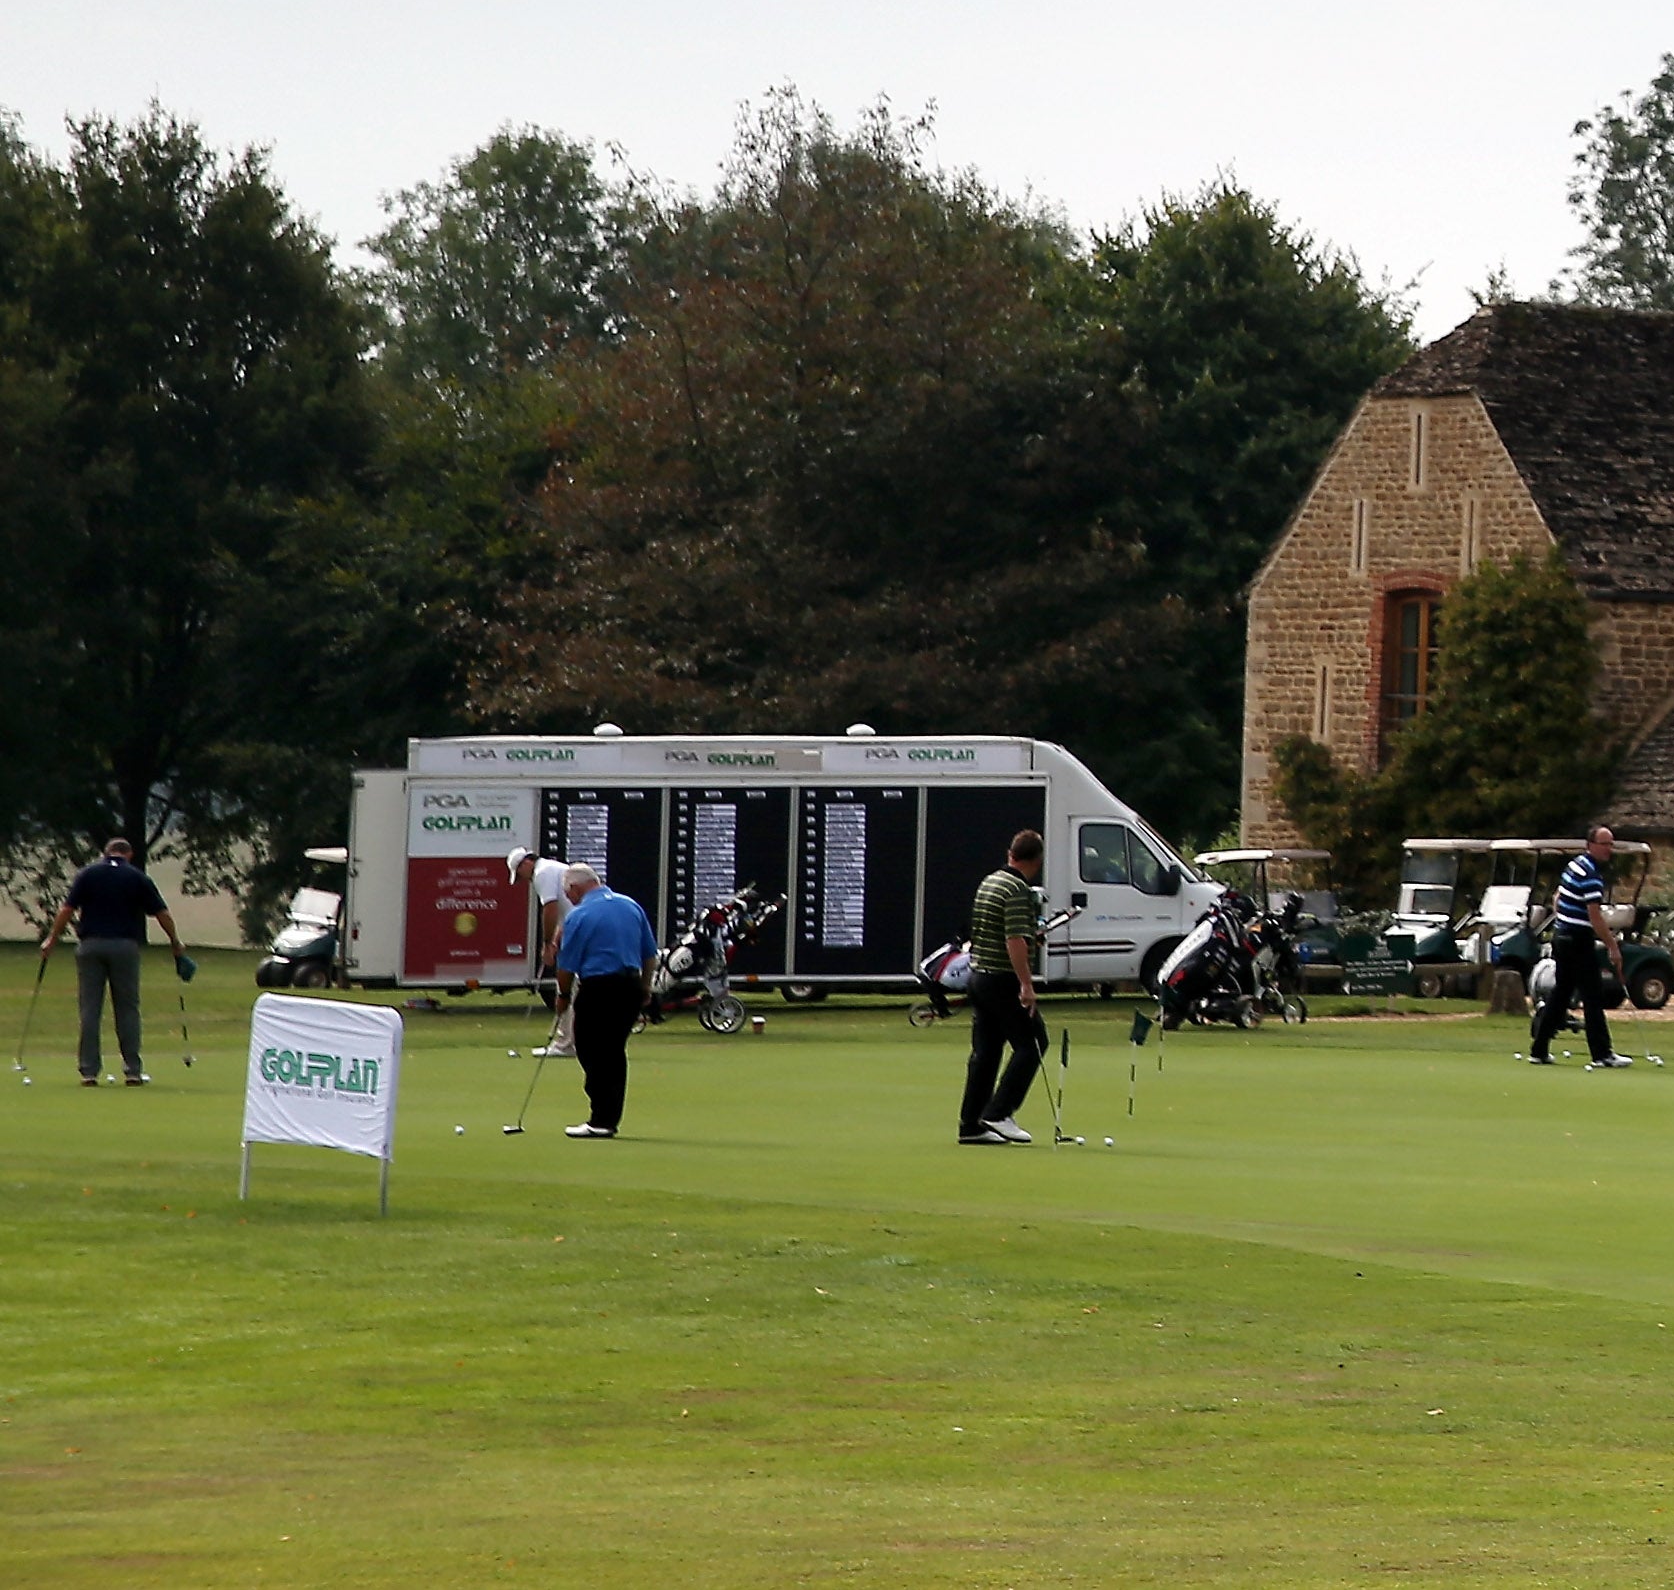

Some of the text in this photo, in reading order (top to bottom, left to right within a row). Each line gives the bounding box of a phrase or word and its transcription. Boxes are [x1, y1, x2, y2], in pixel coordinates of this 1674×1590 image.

[463, 748, 575, 761] PGA GOLFPLAN
[665, 750, 776, 767] PGA GOLFPLAN
[866, 748, 975, 762] PGA GOLFPLAN
[423, 794, 470, 808] PGA
[423, 815, 511, 831] GOLFPLAN
[436, 897, 498, 910] difference
[261, 1048, 379, 1096] GOLFPLAN
